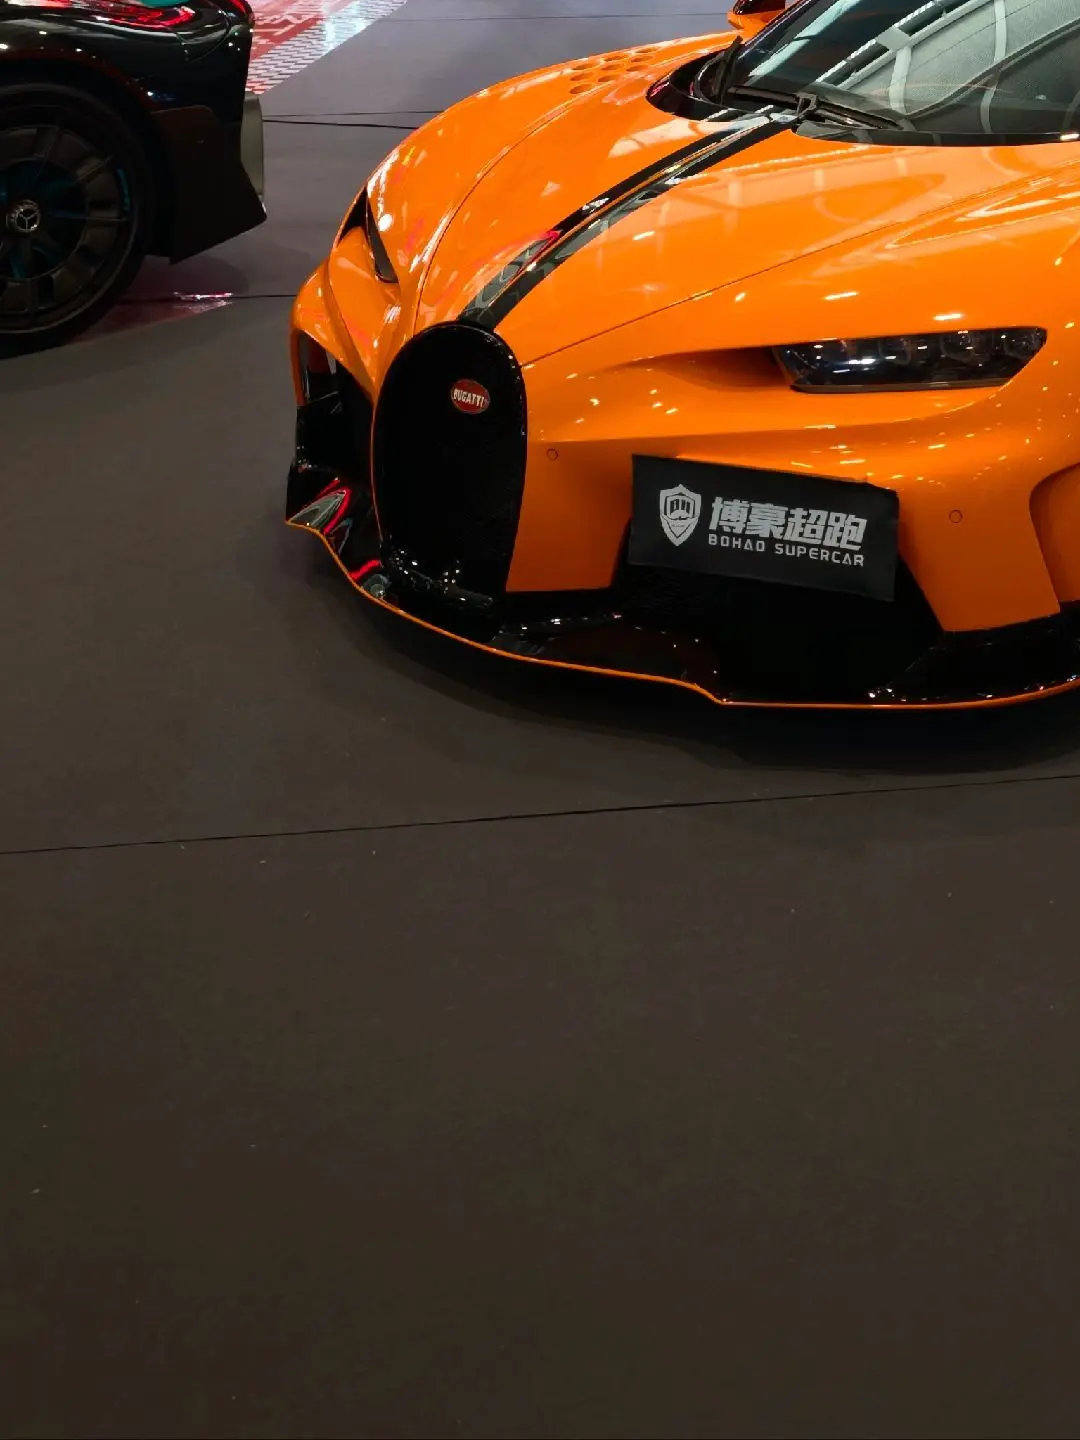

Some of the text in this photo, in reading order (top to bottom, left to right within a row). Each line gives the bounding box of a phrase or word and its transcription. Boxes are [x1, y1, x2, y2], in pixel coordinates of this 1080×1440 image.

[453, 388, 485, 408] BUGATTI
[709, 496, 868, 551] 博豪超跑
[708, 533, 865, 568] BOHAO SUPERCAR
